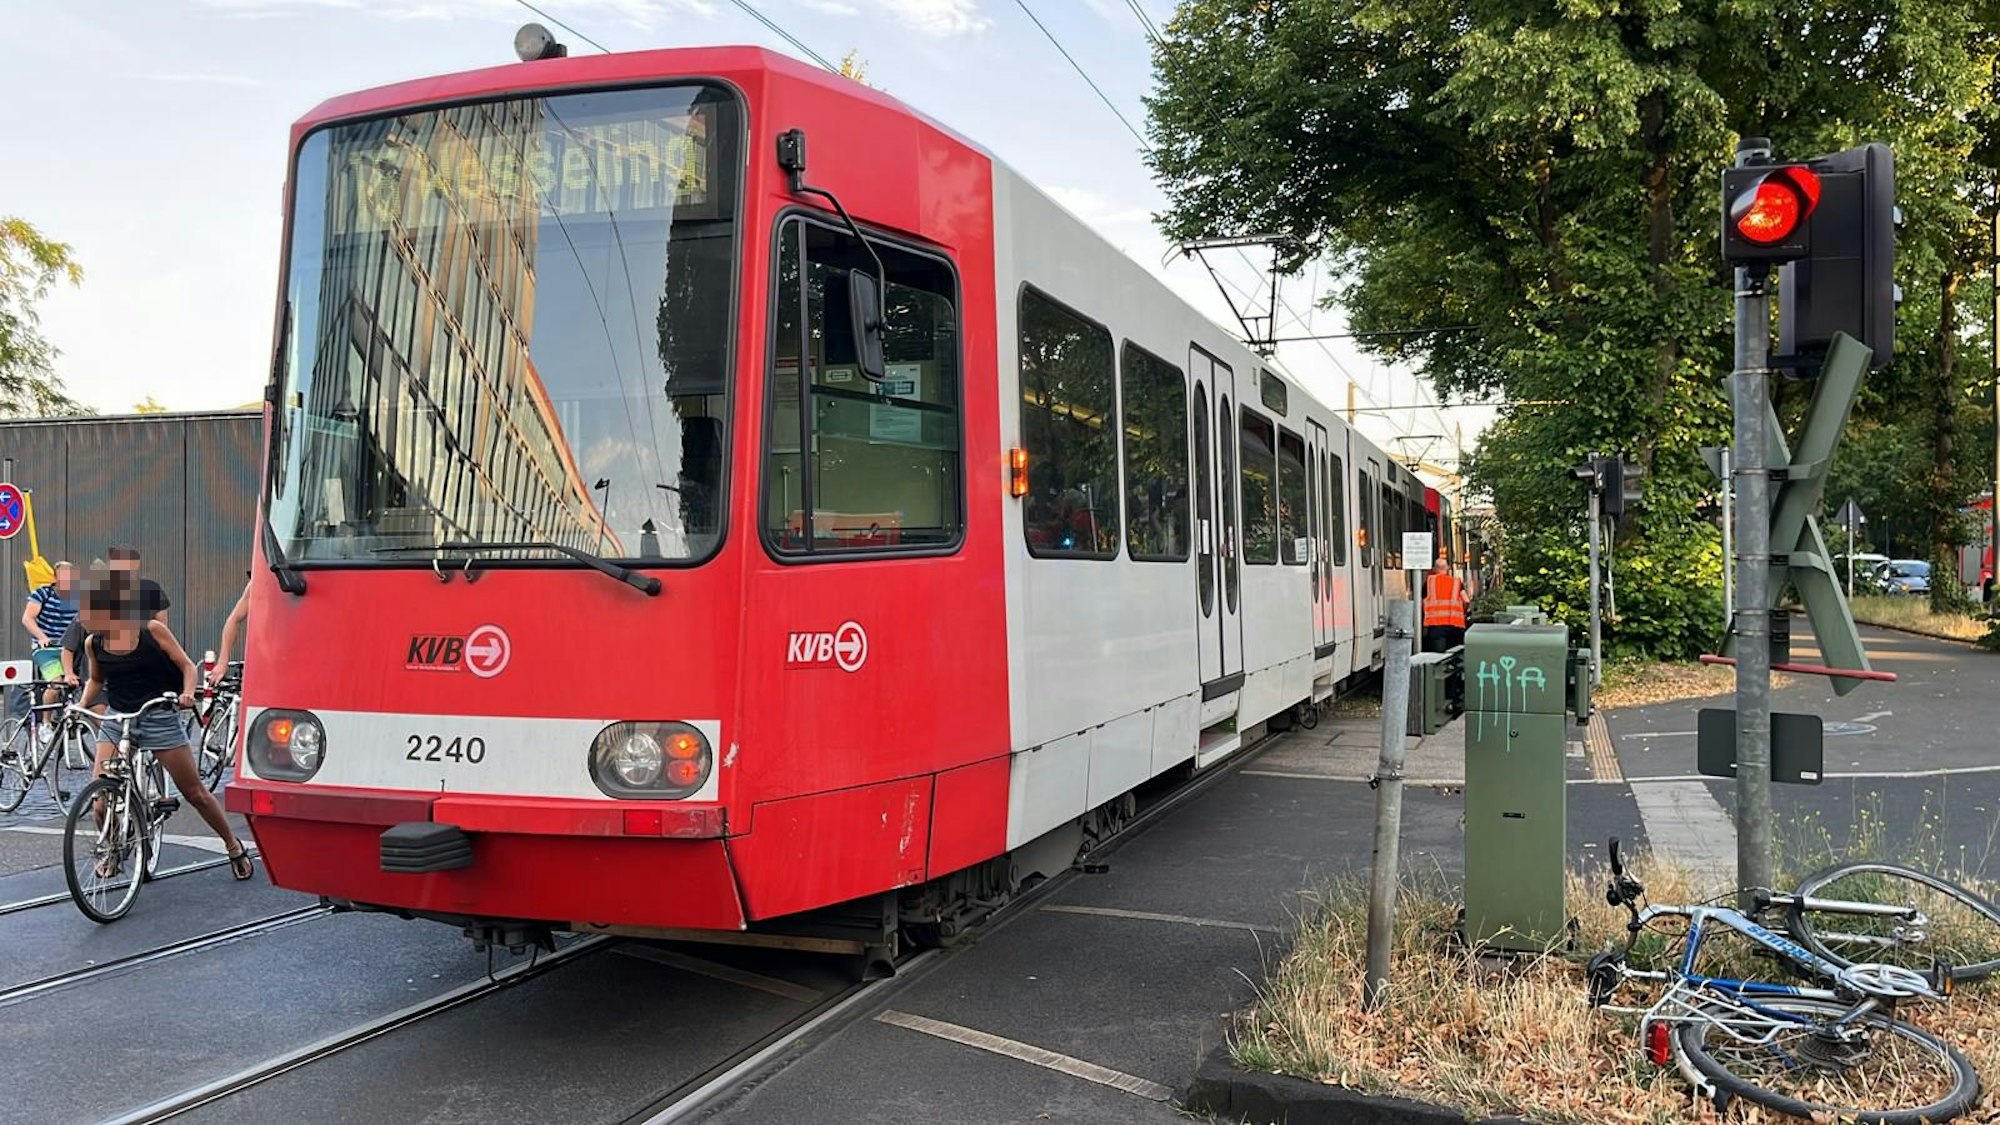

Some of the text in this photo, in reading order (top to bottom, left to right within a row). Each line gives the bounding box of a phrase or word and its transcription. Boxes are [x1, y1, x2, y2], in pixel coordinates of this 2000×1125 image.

[407, 636, 464, 665] KVB
[787, 632, 834, 664] KVB
[406, 734, 486, 764] 2240
